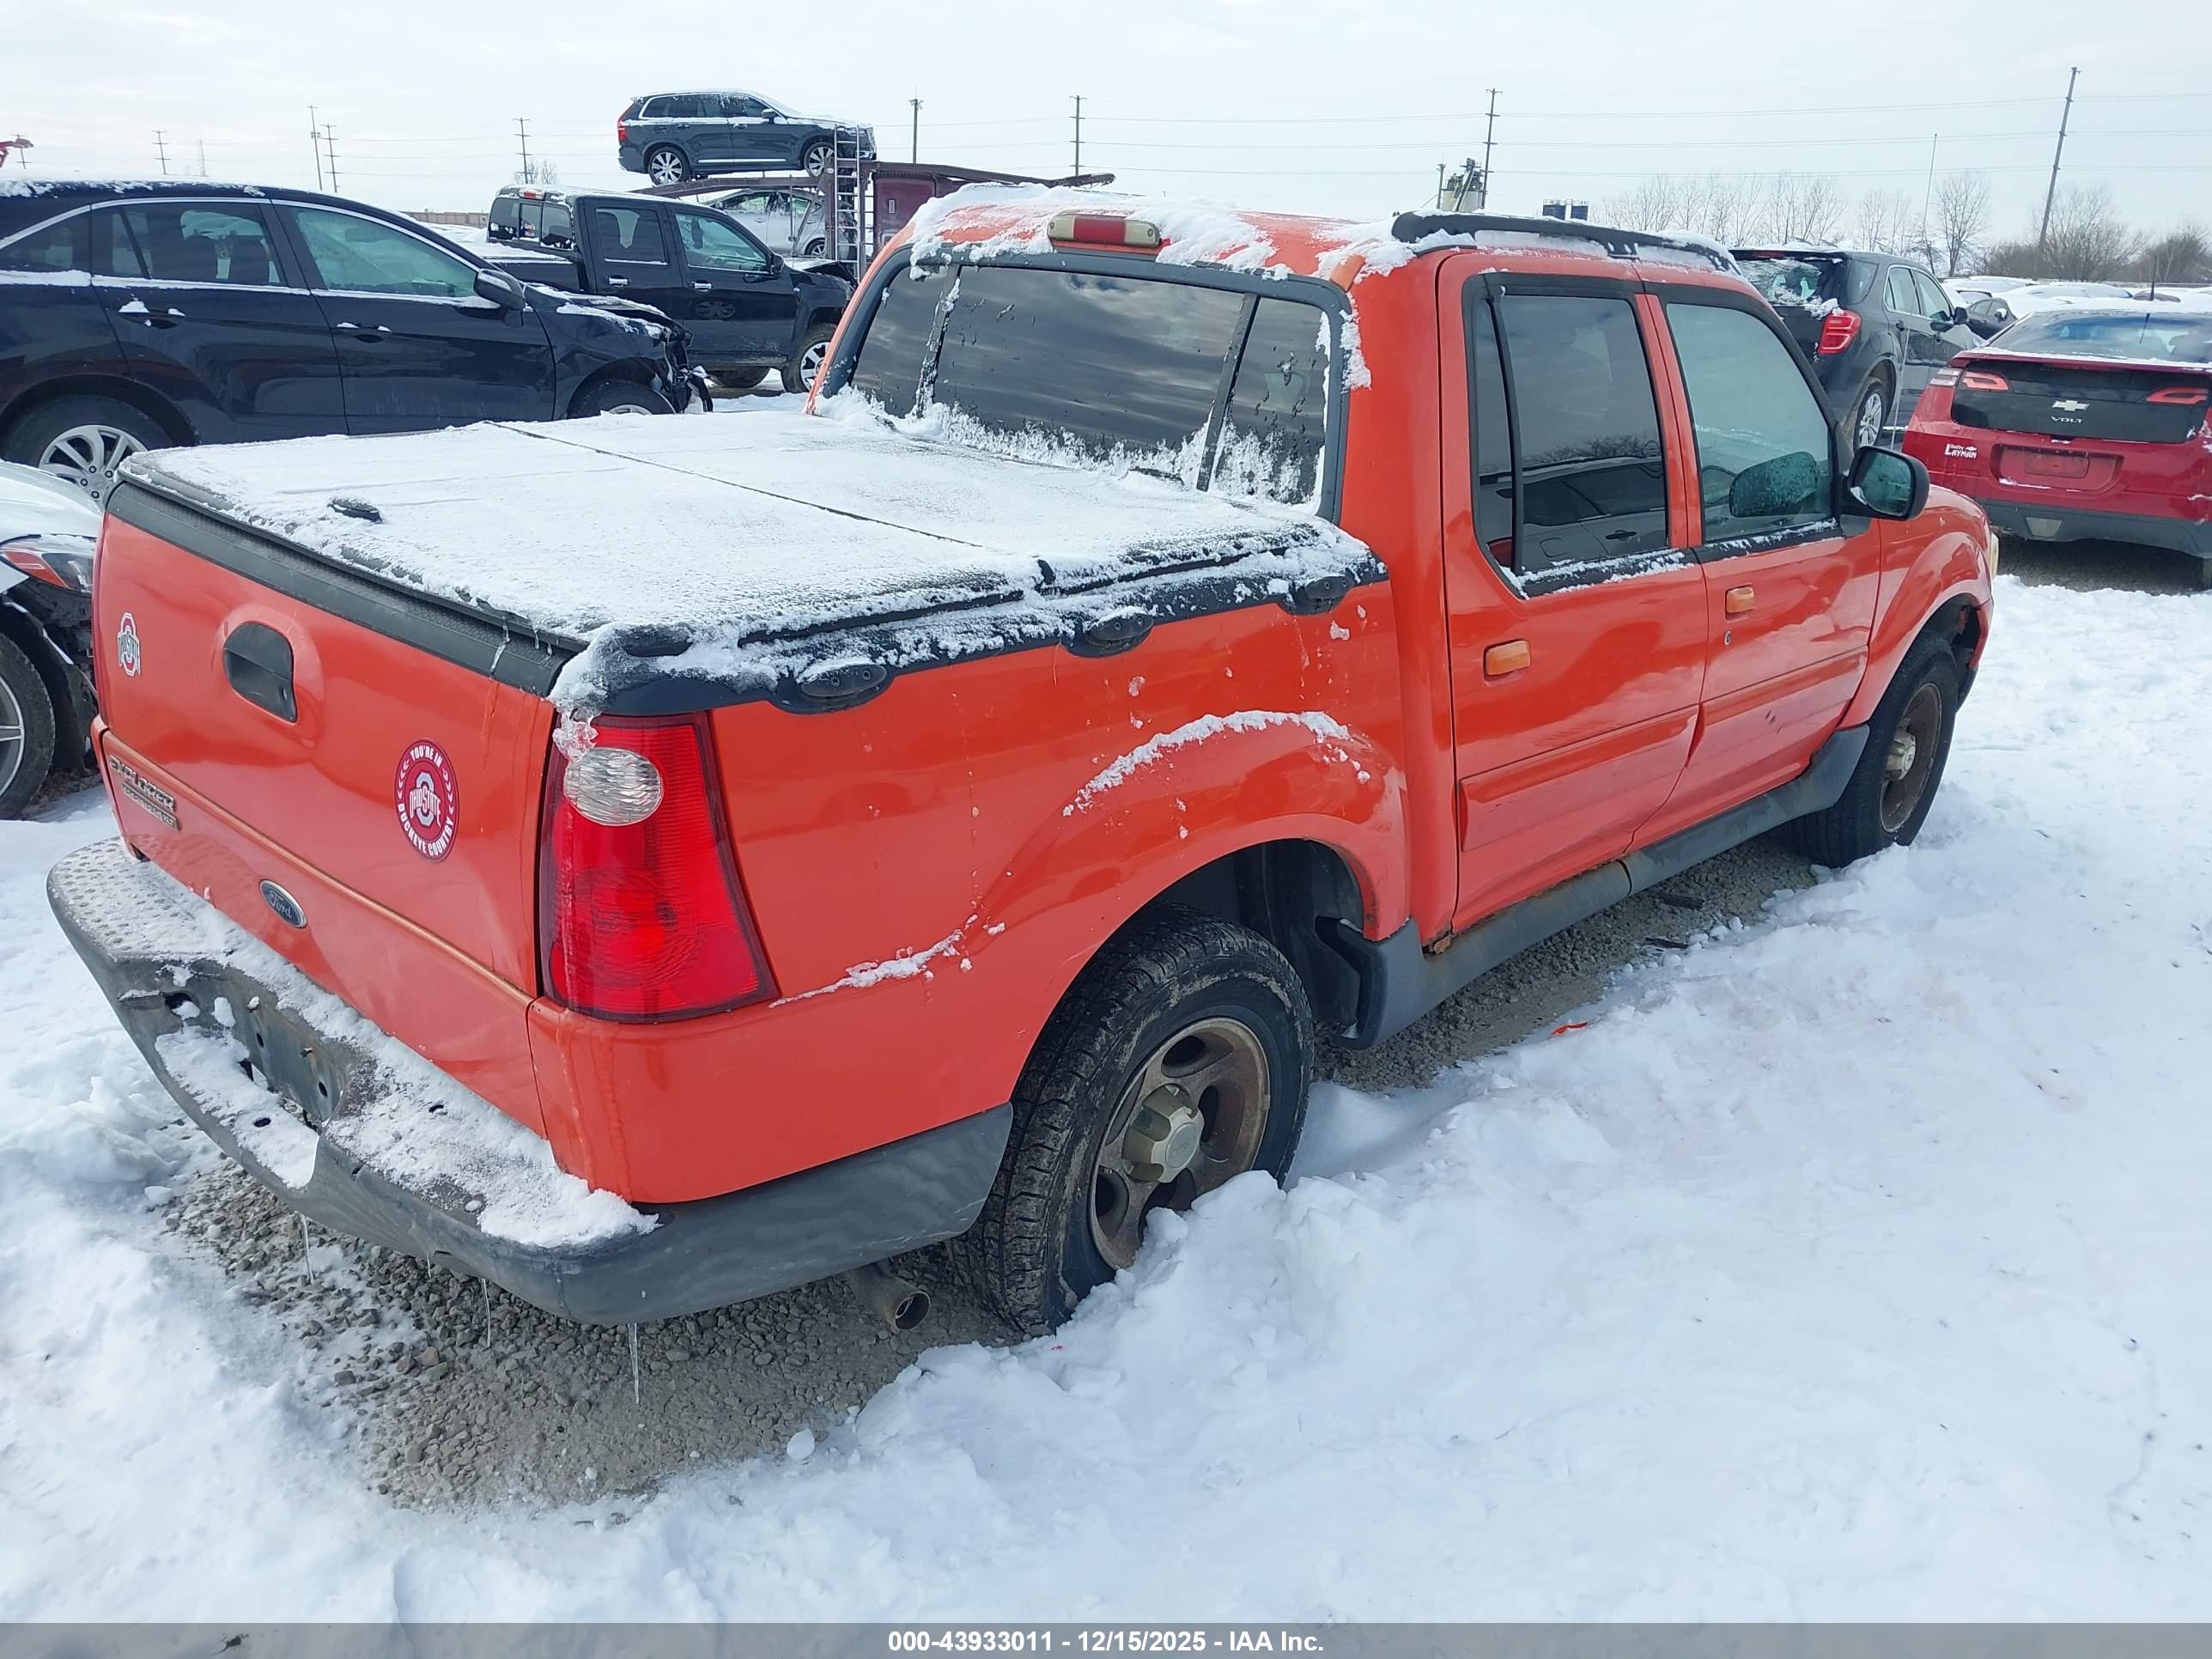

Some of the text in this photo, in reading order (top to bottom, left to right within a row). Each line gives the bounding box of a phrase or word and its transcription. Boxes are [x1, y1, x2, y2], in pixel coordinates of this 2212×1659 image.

[2051, 416, 2082, 424] VOLT
[1944, 443, 1978, 459] LAYMAN
[410, 744, 443, 768] YOU'RE IN
[108, 755, 177, 812] EXPLORER
[397, 802, 454, 857] BUCKEYE COUNTRY
[268, 889, 294, 919] Ford
